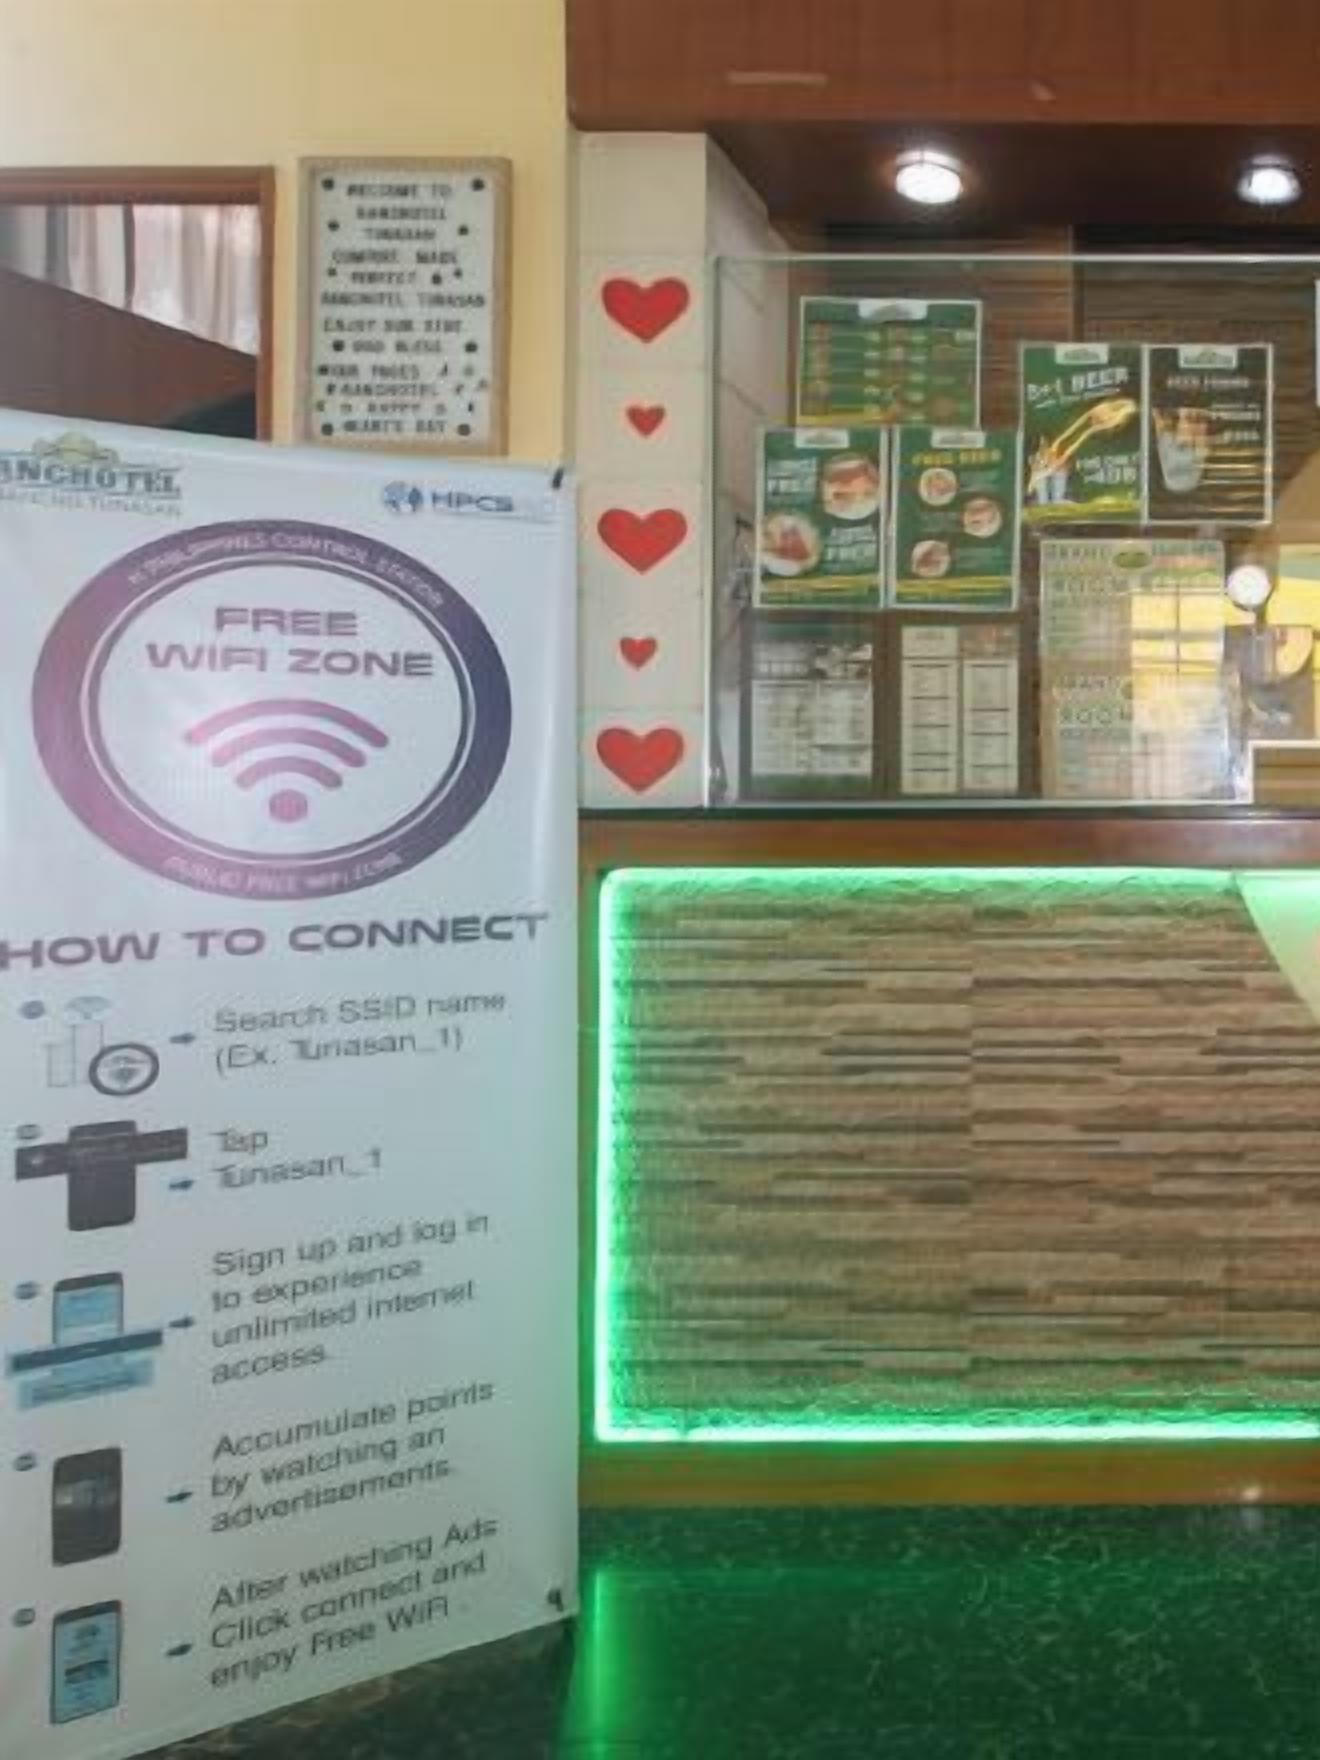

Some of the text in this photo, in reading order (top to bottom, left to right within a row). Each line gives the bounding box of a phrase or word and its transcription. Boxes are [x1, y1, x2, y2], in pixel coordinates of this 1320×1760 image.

[215, 606, 359, 637] FREE
[145, 642, 436, 677] WIFI ZONE
[0, 911, 549, 971] HOW TO CONNECT
[213, 1005, 328, 1035] Search
[338, 995, 417, 1025] SSID
[211, 1212, 490, 1278] Sign up and log in
[211, 1279, 475, 1348] unlimited internet
[212, 1258, 423, 1313] to experience
[211, 1381, 497, 1462] Accumulate points
[210, 1427, 446, 1504] by watching an
[210, 1517, 499, 1614] After watching Ads
[210, 1551, 486, 1649] Click connect and
[209, 1643, 299, 1689] enjoy
[310, 1624, 377, 1657] Free
